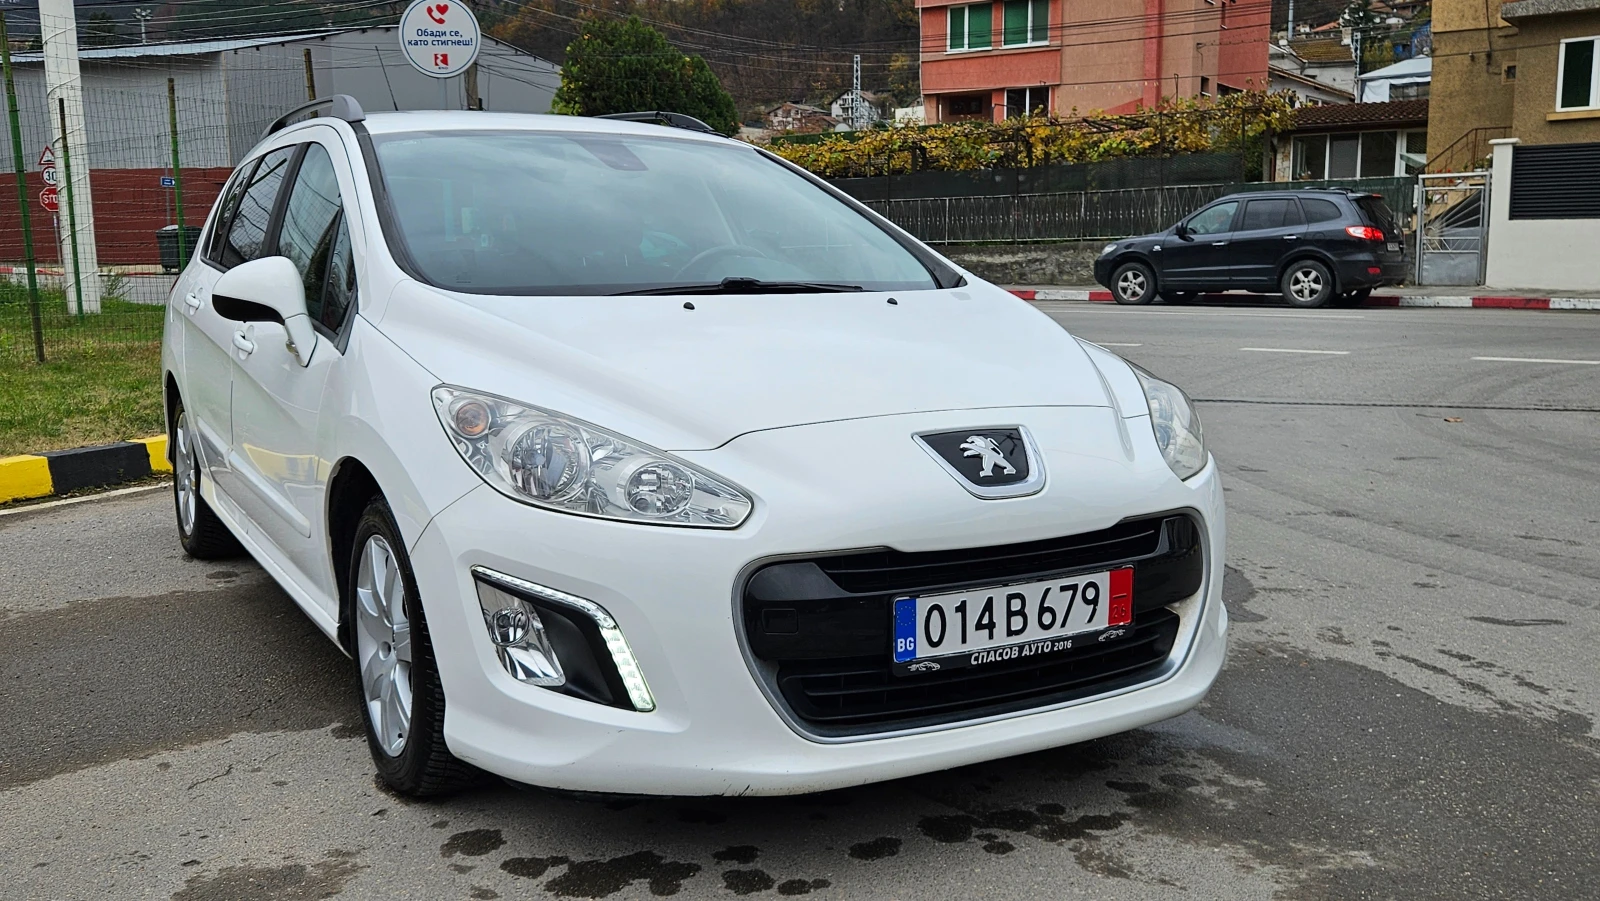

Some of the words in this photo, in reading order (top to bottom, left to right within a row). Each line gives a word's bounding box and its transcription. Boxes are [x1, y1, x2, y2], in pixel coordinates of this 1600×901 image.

[416, 28, 447, 38] Обади
[449, 30, 463, 38] се,
[431, 38, 473, 46] стигнеш!
[43, 194, 58, 203] STO
[897, 637, 915, 653] BG
[970, 648, 1019, 666] СПАСОВ
[1021, 641, 1052, 657] АУТО
[1054, 640, 1072, 652] 2016
